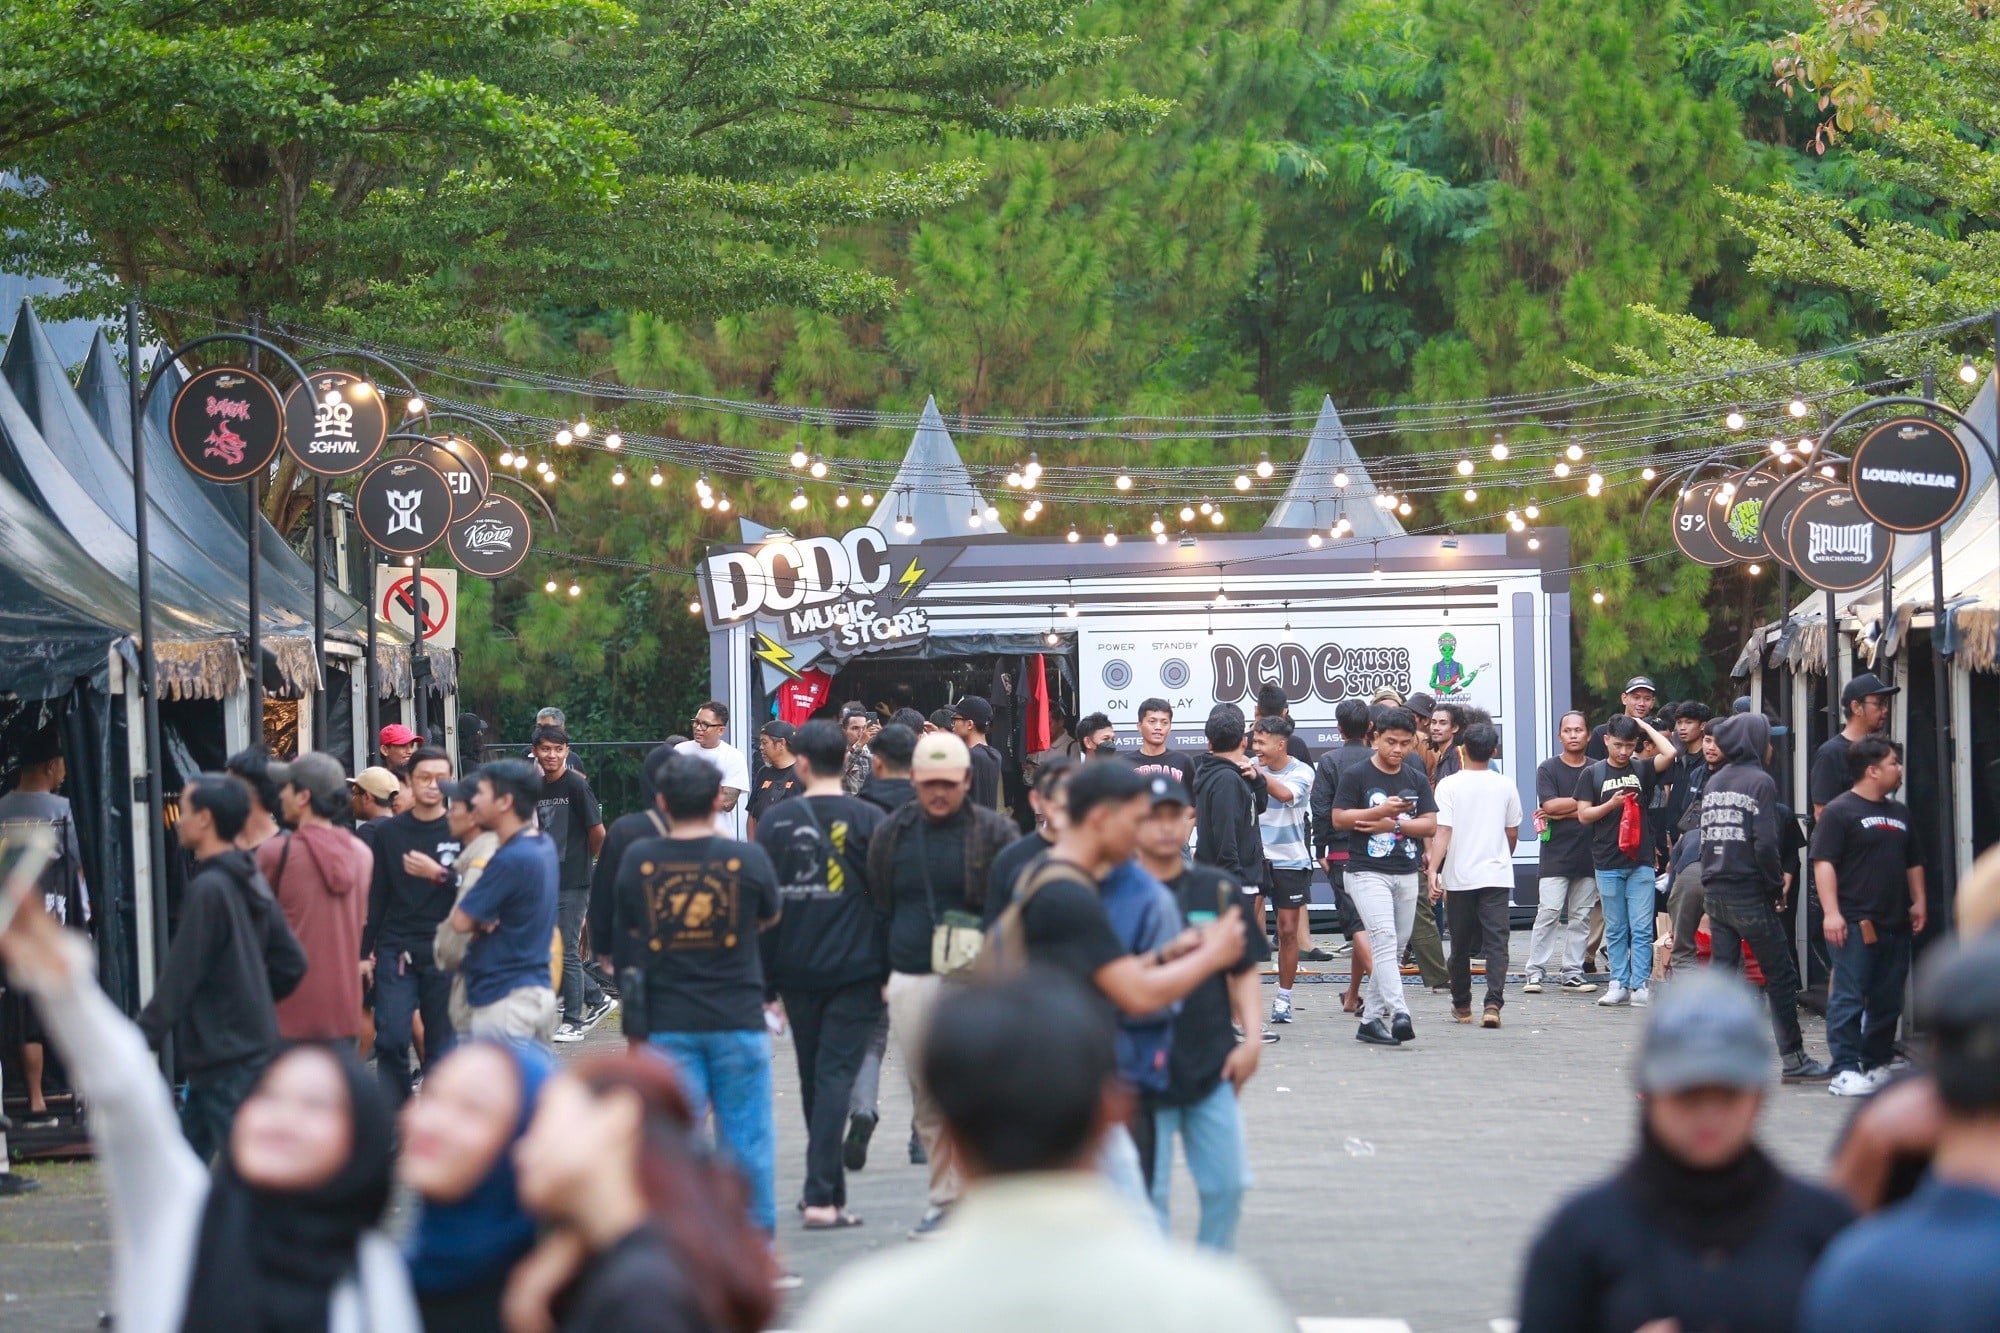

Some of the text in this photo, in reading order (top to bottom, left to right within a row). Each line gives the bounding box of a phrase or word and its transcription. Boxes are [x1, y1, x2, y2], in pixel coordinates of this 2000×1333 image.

[708, 526, 891, 620] DCDC
[790, 599, 878, 635] MUSIC
[842, 609, 930, 646] STORE
[1098, 641, 1198, 651] POWER STANDBY
[1345, 647, 1411, 673] MUSIC
[1210, 642, 1347, 704] DCDC
[1107, 698, 1194, 710] ON LAY
[1112, 736, 1144, 746] ASTE
[1175, 736, 1209, 745] TREBL
